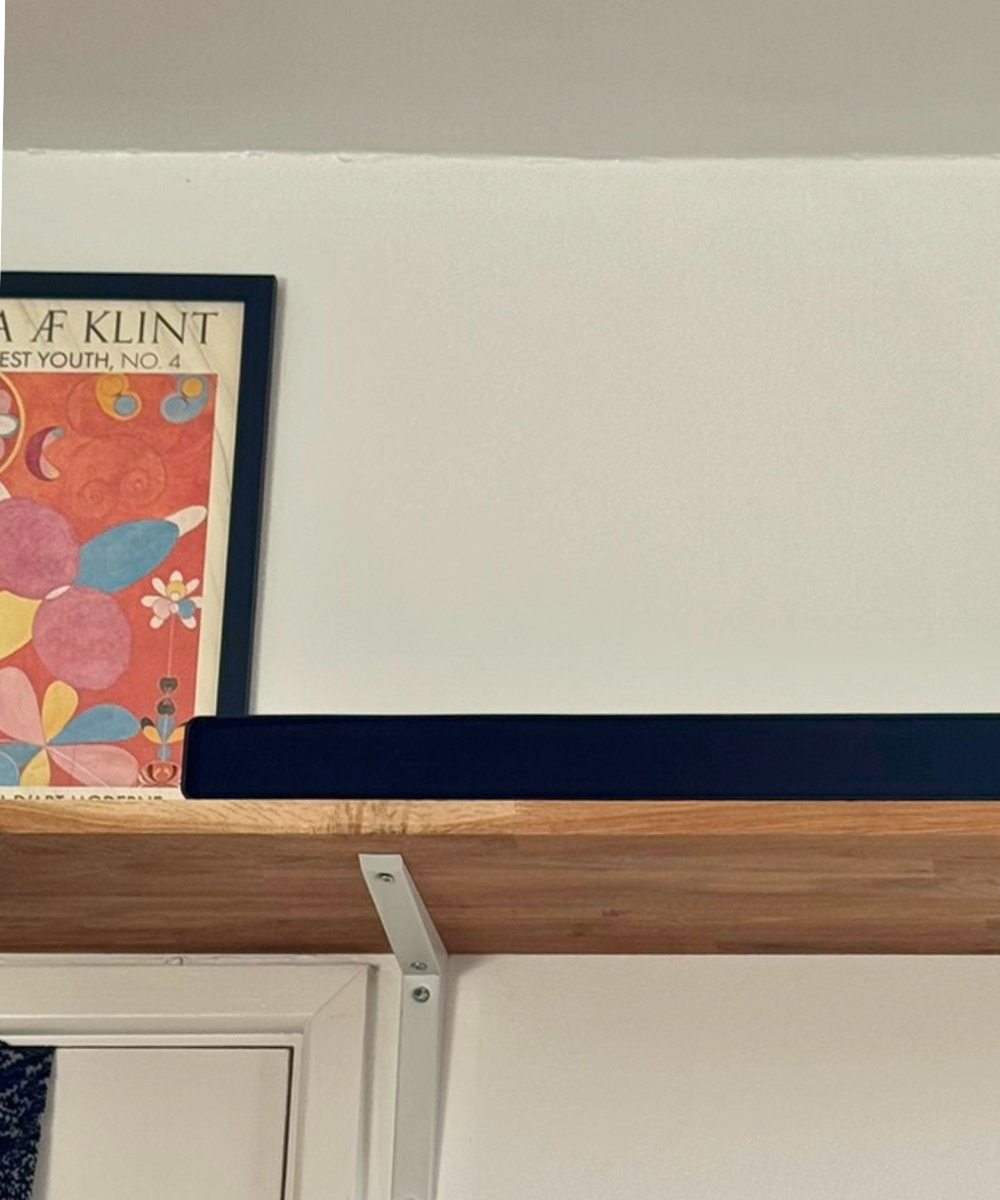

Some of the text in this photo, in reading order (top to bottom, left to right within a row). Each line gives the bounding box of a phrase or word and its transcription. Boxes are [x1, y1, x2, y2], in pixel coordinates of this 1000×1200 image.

[84, 310, 219, 345] KLINT
[0, 351, 181, 371] EST YOUTH, NO. 4
